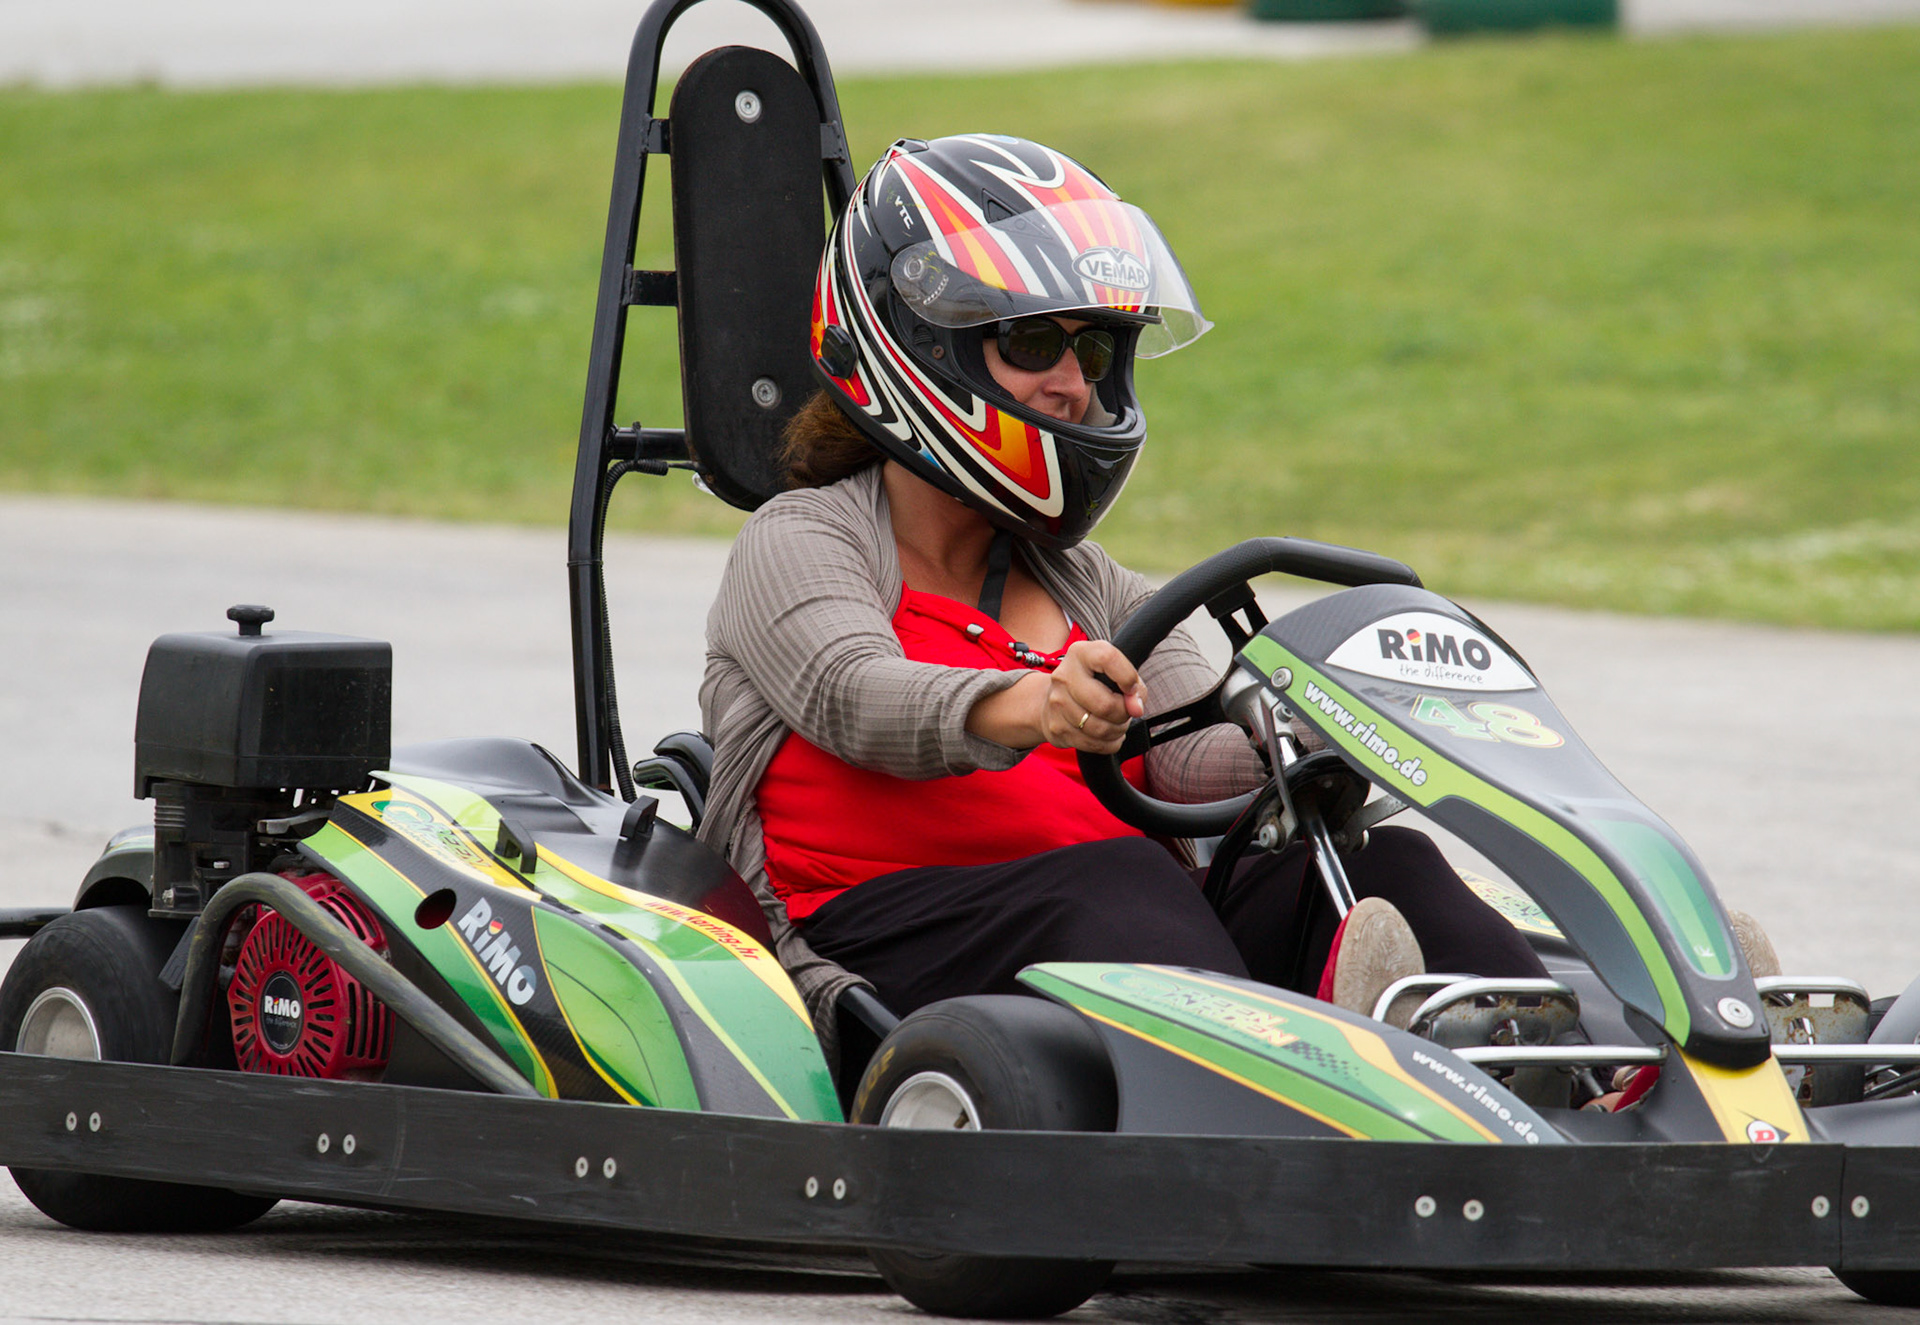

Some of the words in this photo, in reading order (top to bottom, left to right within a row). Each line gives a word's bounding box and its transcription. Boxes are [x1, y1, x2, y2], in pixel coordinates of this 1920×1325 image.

[1085, 260, 1146, 286] VEMAR
[1399, 664, 1419, 676] the
[1425, 662, 1484, 684] difference
[1304, 680, 1428, 787] www.rimo.de
[1410, 694, 1565, 748] 48
[1412, 1051, 1540, 1144] www.rimo.de
